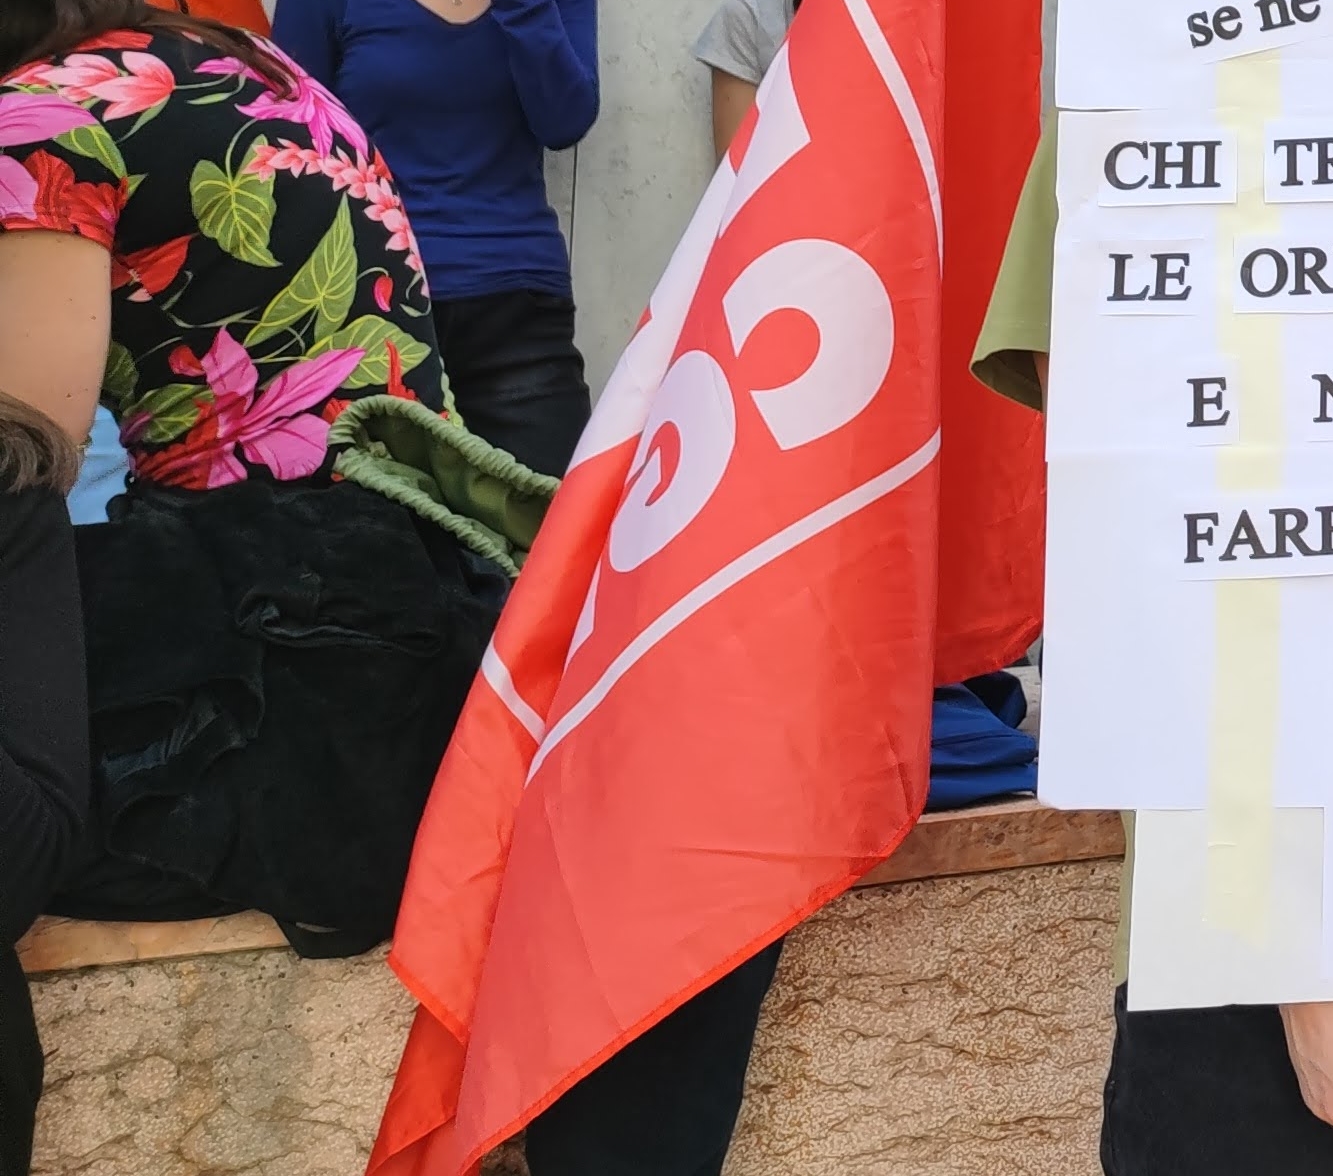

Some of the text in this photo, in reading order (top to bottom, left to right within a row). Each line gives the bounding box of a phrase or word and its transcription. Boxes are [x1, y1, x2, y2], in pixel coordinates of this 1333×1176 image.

[1188, 6, 1242, 48] se
[1105, 141, 1221, 190] CHI
[1107, 253, 1191, 301] LE
[1187, 377, 1229, 427] E
